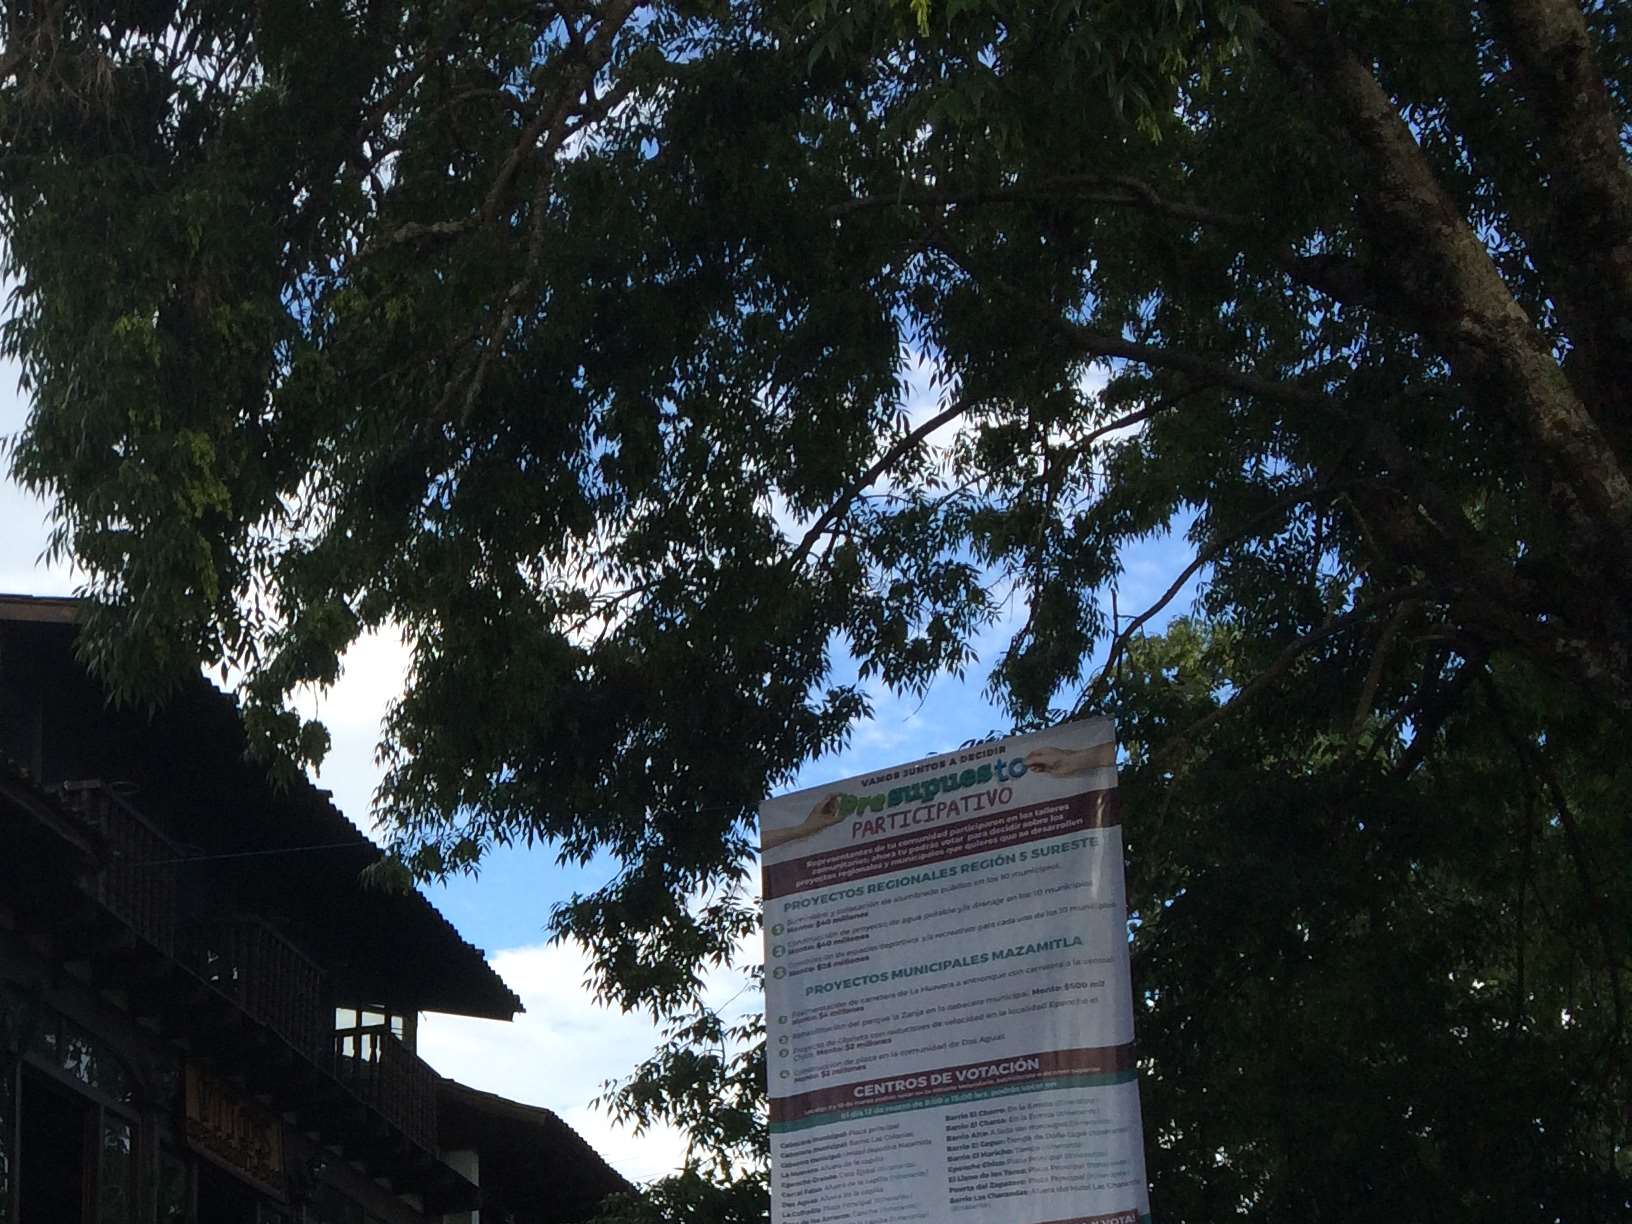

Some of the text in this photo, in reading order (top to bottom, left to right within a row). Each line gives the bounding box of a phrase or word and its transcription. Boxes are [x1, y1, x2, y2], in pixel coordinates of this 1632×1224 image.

[861, 745, 1007, 787] VAMOS JUNTOS A DECIDIR
[852, 786, 1013, 839] PARTICIPATIVO
[874, 844, 885, 853] de
[898, 830, 947, 848] comunidad
[1006, 814, 1016, 824] en
[783, 835, 1098, 912] PROYECTOS REGIONALES REGIÓN 5 SURESTE
[806, 934, 1082, 996] PROYECTOS MUNICIPALES MAZAMITLA
[853, 1075, 928, 1098] CENTROS
[930, 1071, 952, 1085] DE
[955, 1055, 1040, 1081] VOTACIÓN
